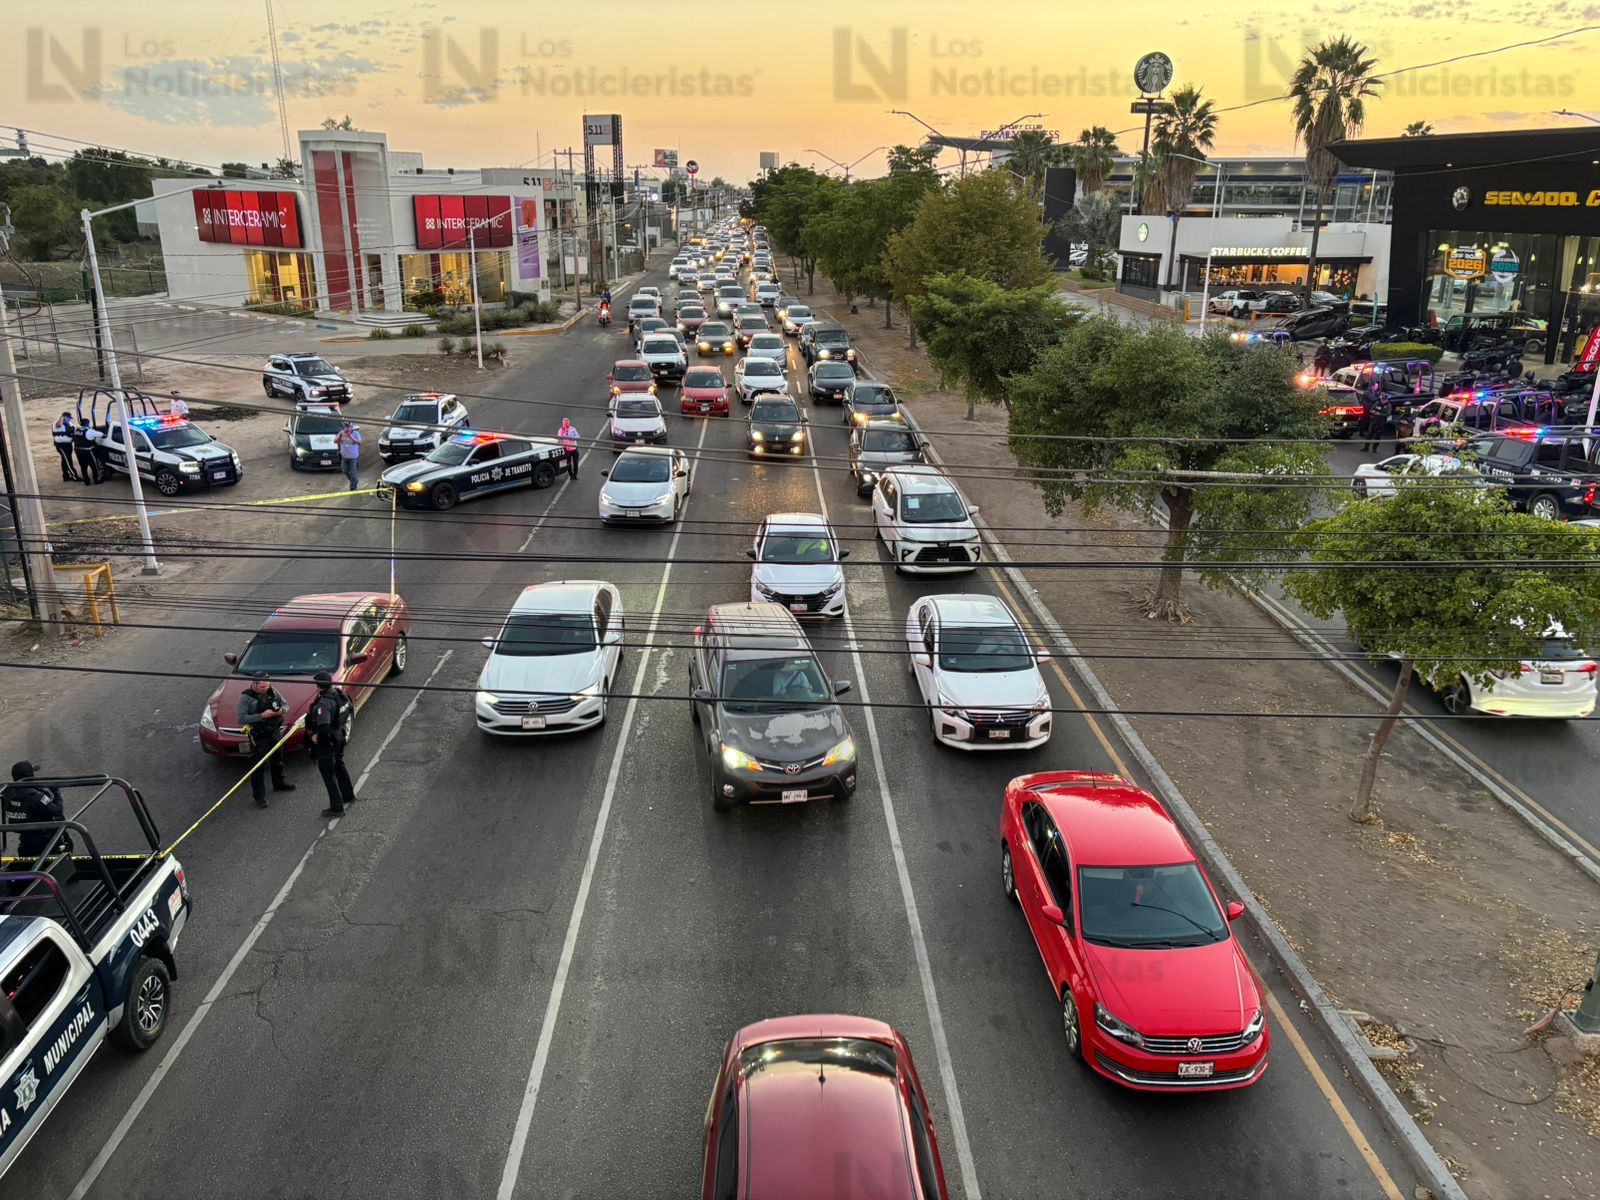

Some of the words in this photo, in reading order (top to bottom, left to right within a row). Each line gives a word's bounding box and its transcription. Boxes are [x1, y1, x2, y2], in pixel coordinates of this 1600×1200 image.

[213, 208, 287, 229] INTERCERAMIC
[437, 216, 504, 229] INTERCERAMIC
[1210, 247, 1269, 257] STARBUCKS
[1271, 247, 1307, 257] COFFEE
[1449, 259, 1483, 271] 2026
[471, 472, 490, 484] POLICIA
[505, 468, 511, 477] DE
[511, 463, 532, 475] TRANSITO
[130, 908, 160, 948] 0443
[43, 1001, 95, 1076] MUNICIPAL
